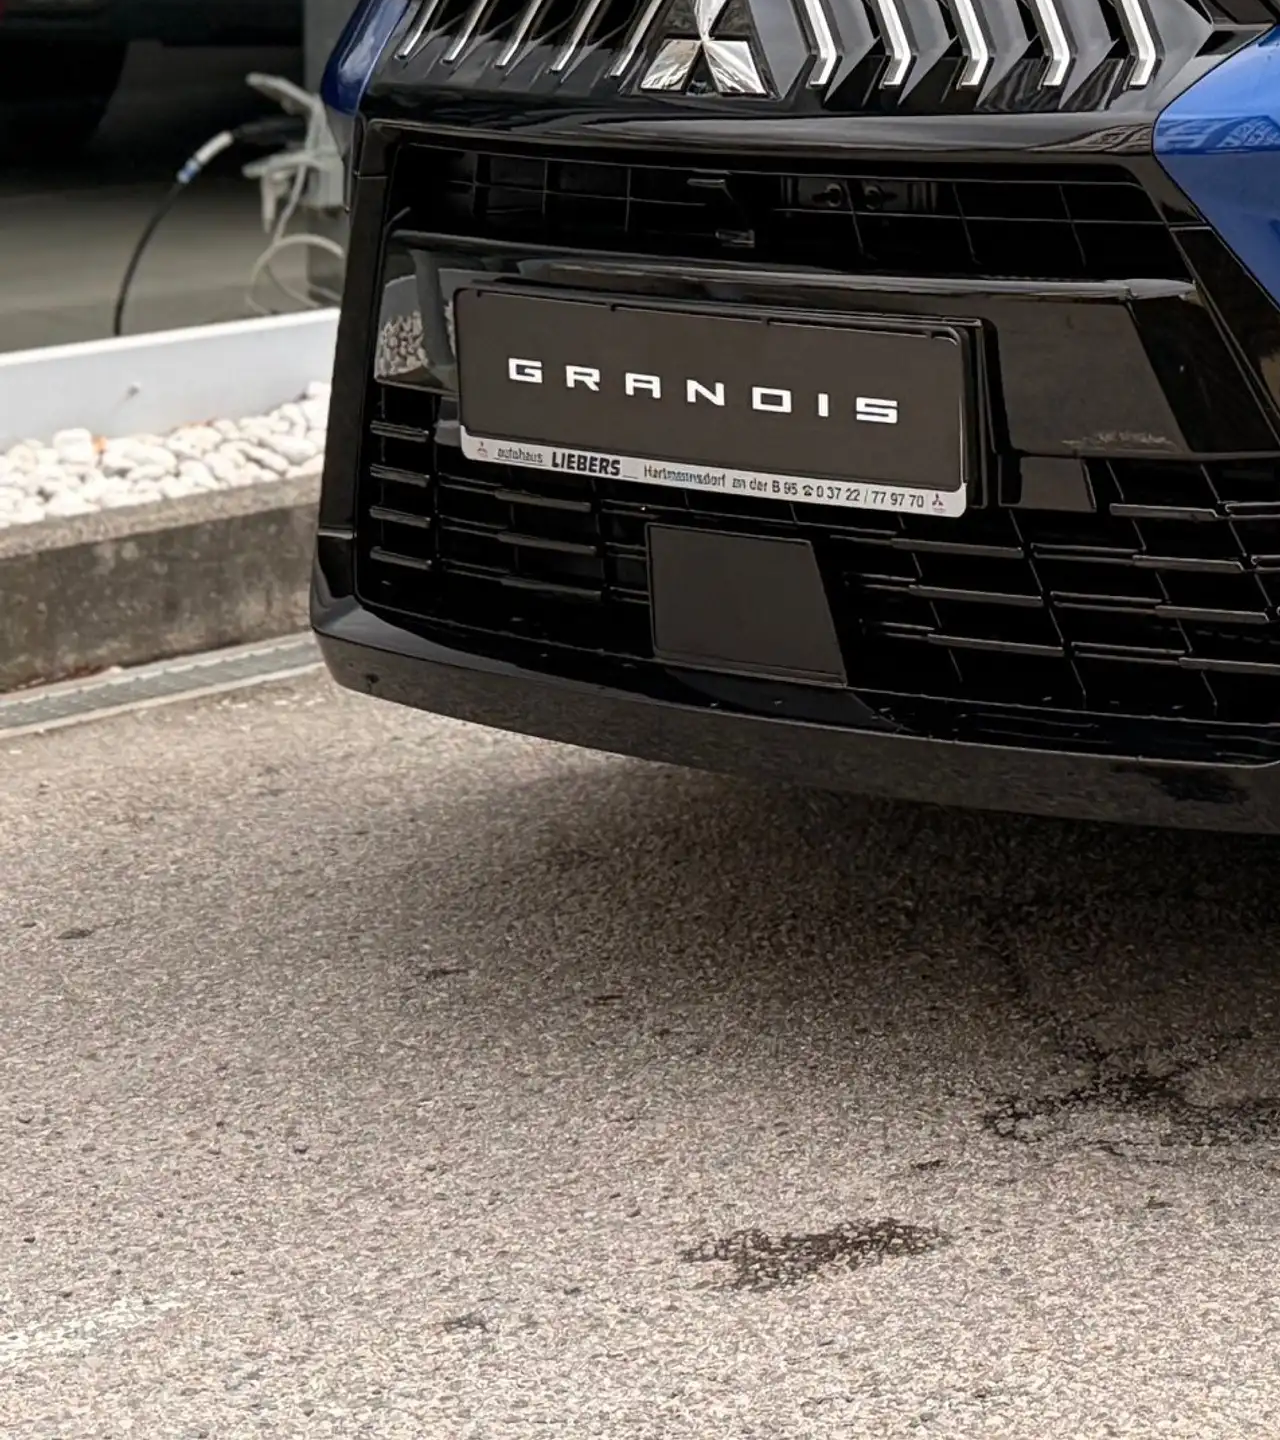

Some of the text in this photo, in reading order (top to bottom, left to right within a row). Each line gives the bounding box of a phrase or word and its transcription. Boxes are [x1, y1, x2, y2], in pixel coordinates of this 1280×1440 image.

[508, 357, 899, 424] GRANDIS
[551, 451, 621, 477] LIEBERS
[772, 479, 781, 493] B
[784, 482, 799, 497] 95
[816, 485, 825, 499] 0
[827, 486, 842, 501] 37
[845, 487, 861, 502] 22
[871, 490, 886, 505] 77
[890, 492, 905, 507] 97
[908, 494, 925, 509] 70
